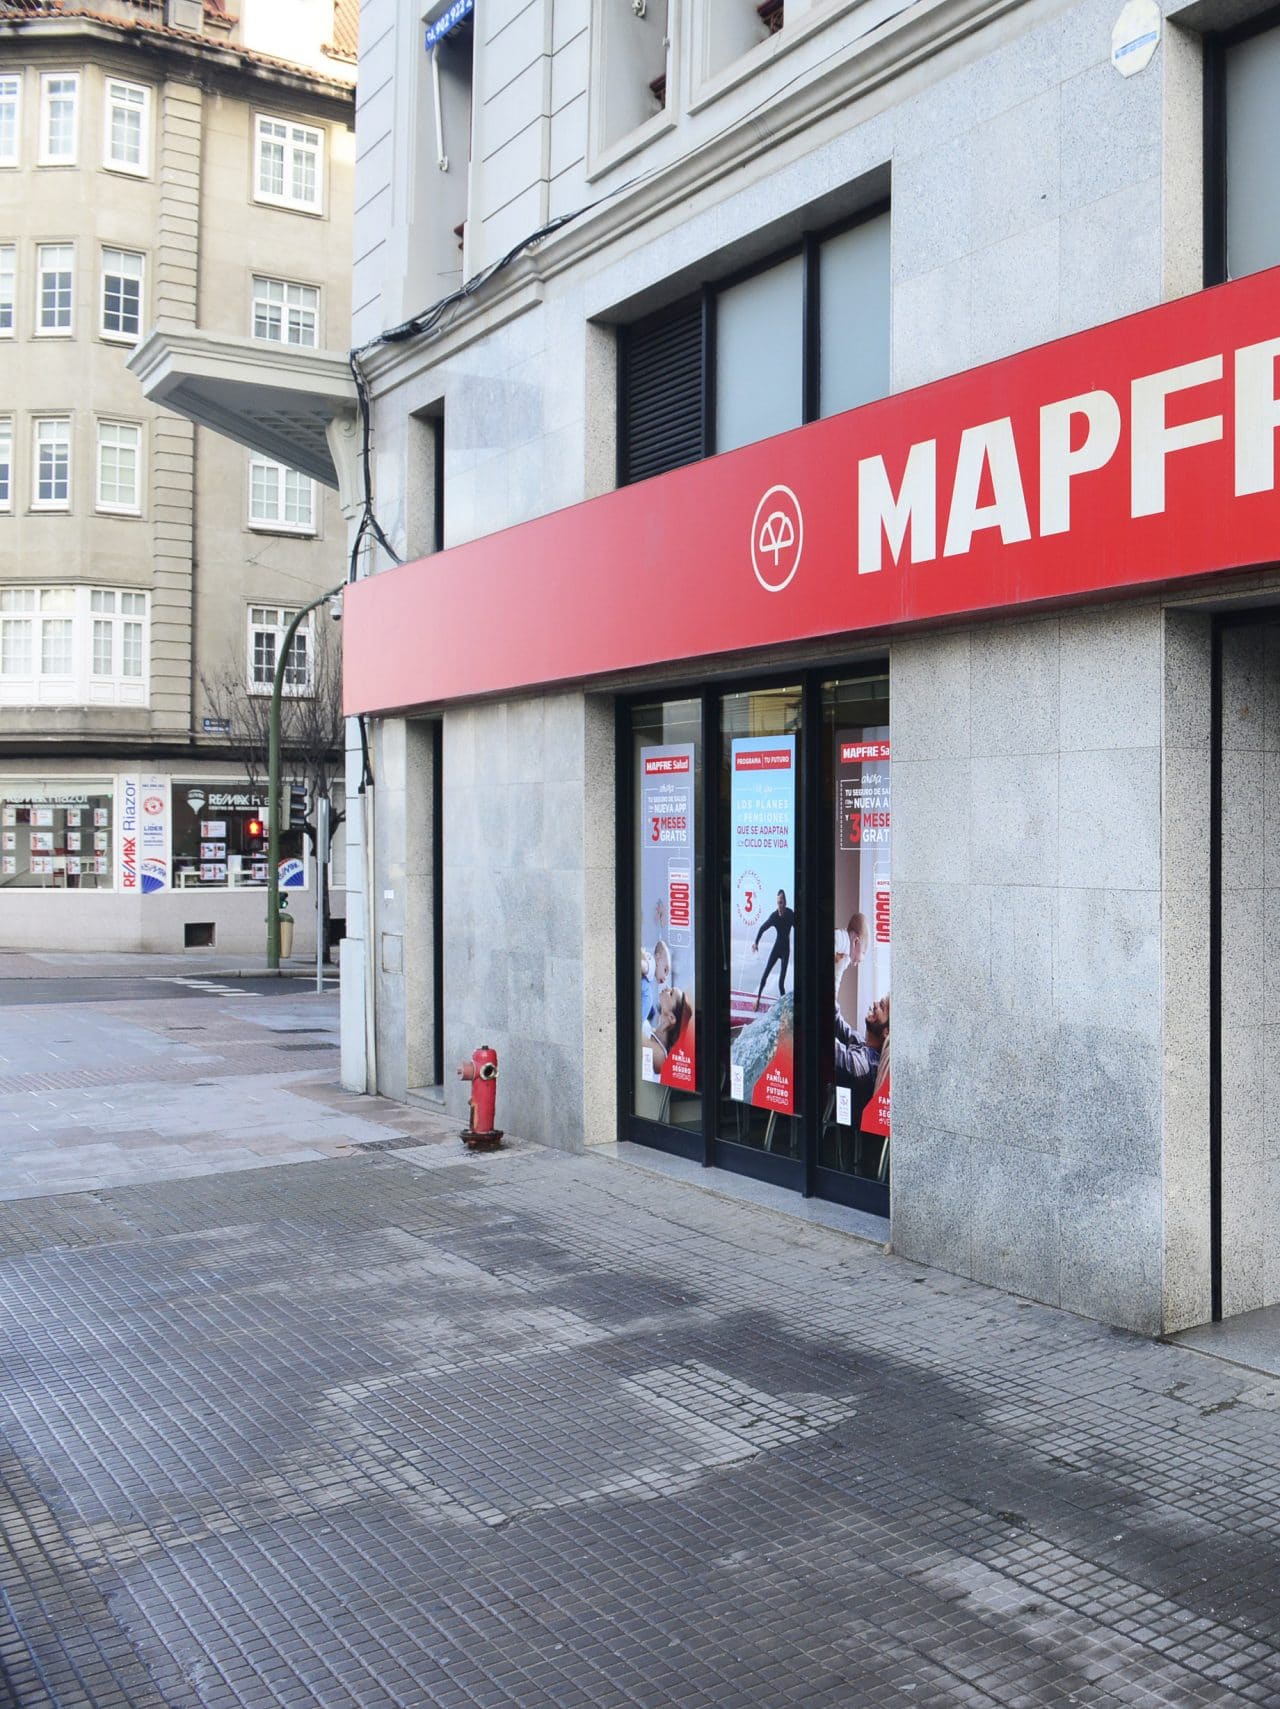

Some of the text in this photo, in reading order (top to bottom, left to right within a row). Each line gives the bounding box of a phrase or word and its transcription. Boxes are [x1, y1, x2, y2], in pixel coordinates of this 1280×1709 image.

[843, 746, 878, 759] MAPFRE
[646, 758, 688, 771] MAPFRE Salud
[208, 794, 249, 805] RE/MAX
[854, 798, 881, 809] NUEVA
[123, 781, 136, 831] Riazor
[651, 816, 686, 842] 3 MESES
[737, 826, 788, 835] QUE SE ADAPTAN
[850, 813, 861, 843] 3
[661, 830, 687, 842] GRATIS
[763, 839, 772, 848] DE
[774, 839, 788, 848] VIDA
[122, 837, 136, 887] RE/MAX
[767, 1073, 789, 1084] FAMILIA
[767, 1086, 789, 1097] FUTURO
